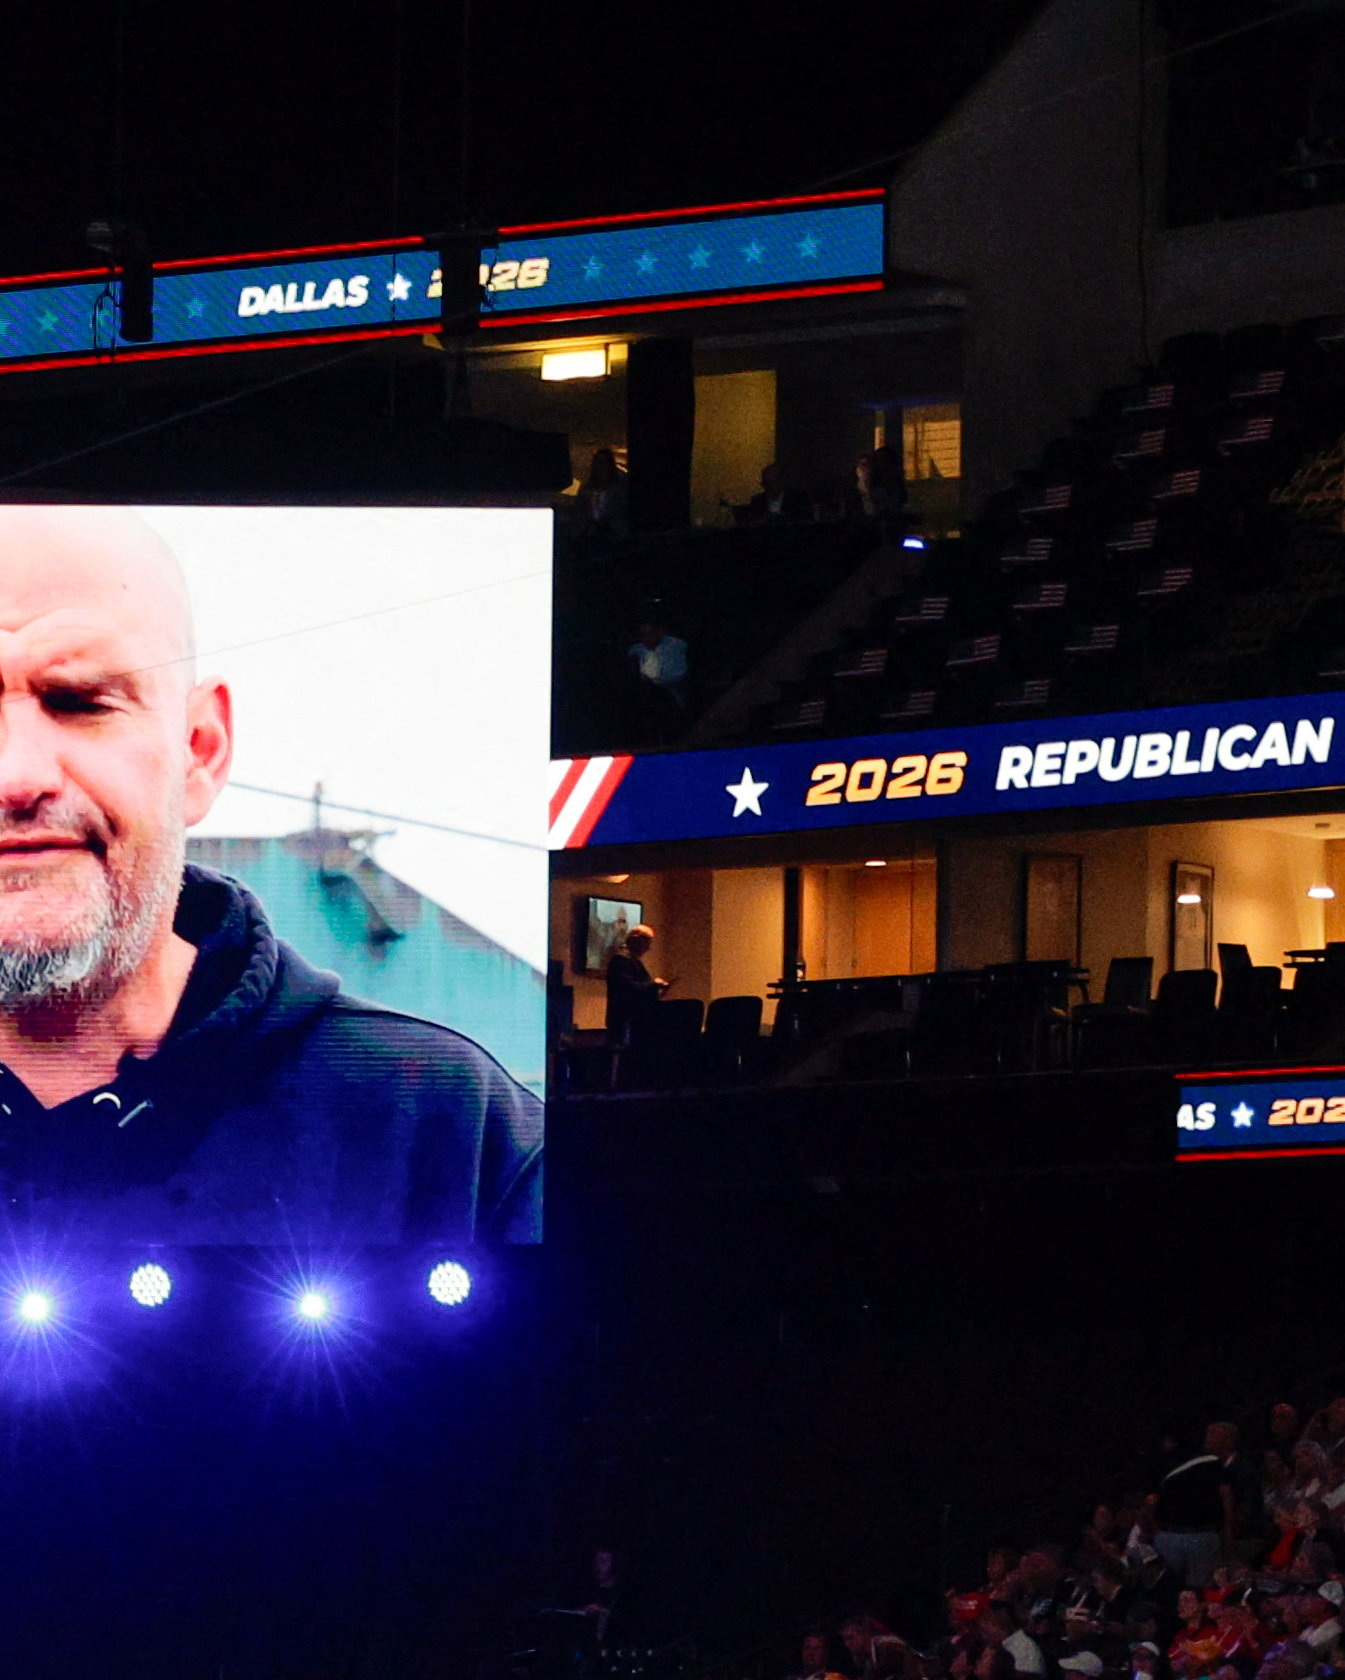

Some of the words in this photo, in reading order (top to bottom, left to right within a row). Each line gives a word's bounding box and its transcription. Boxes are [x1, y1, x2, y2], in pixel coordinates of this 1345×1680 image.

[238, 275, 370, 318] DALLAS
[805, 751, 969, 807] 2026
[995, 717, 1335, 791] REPUBLICAN
